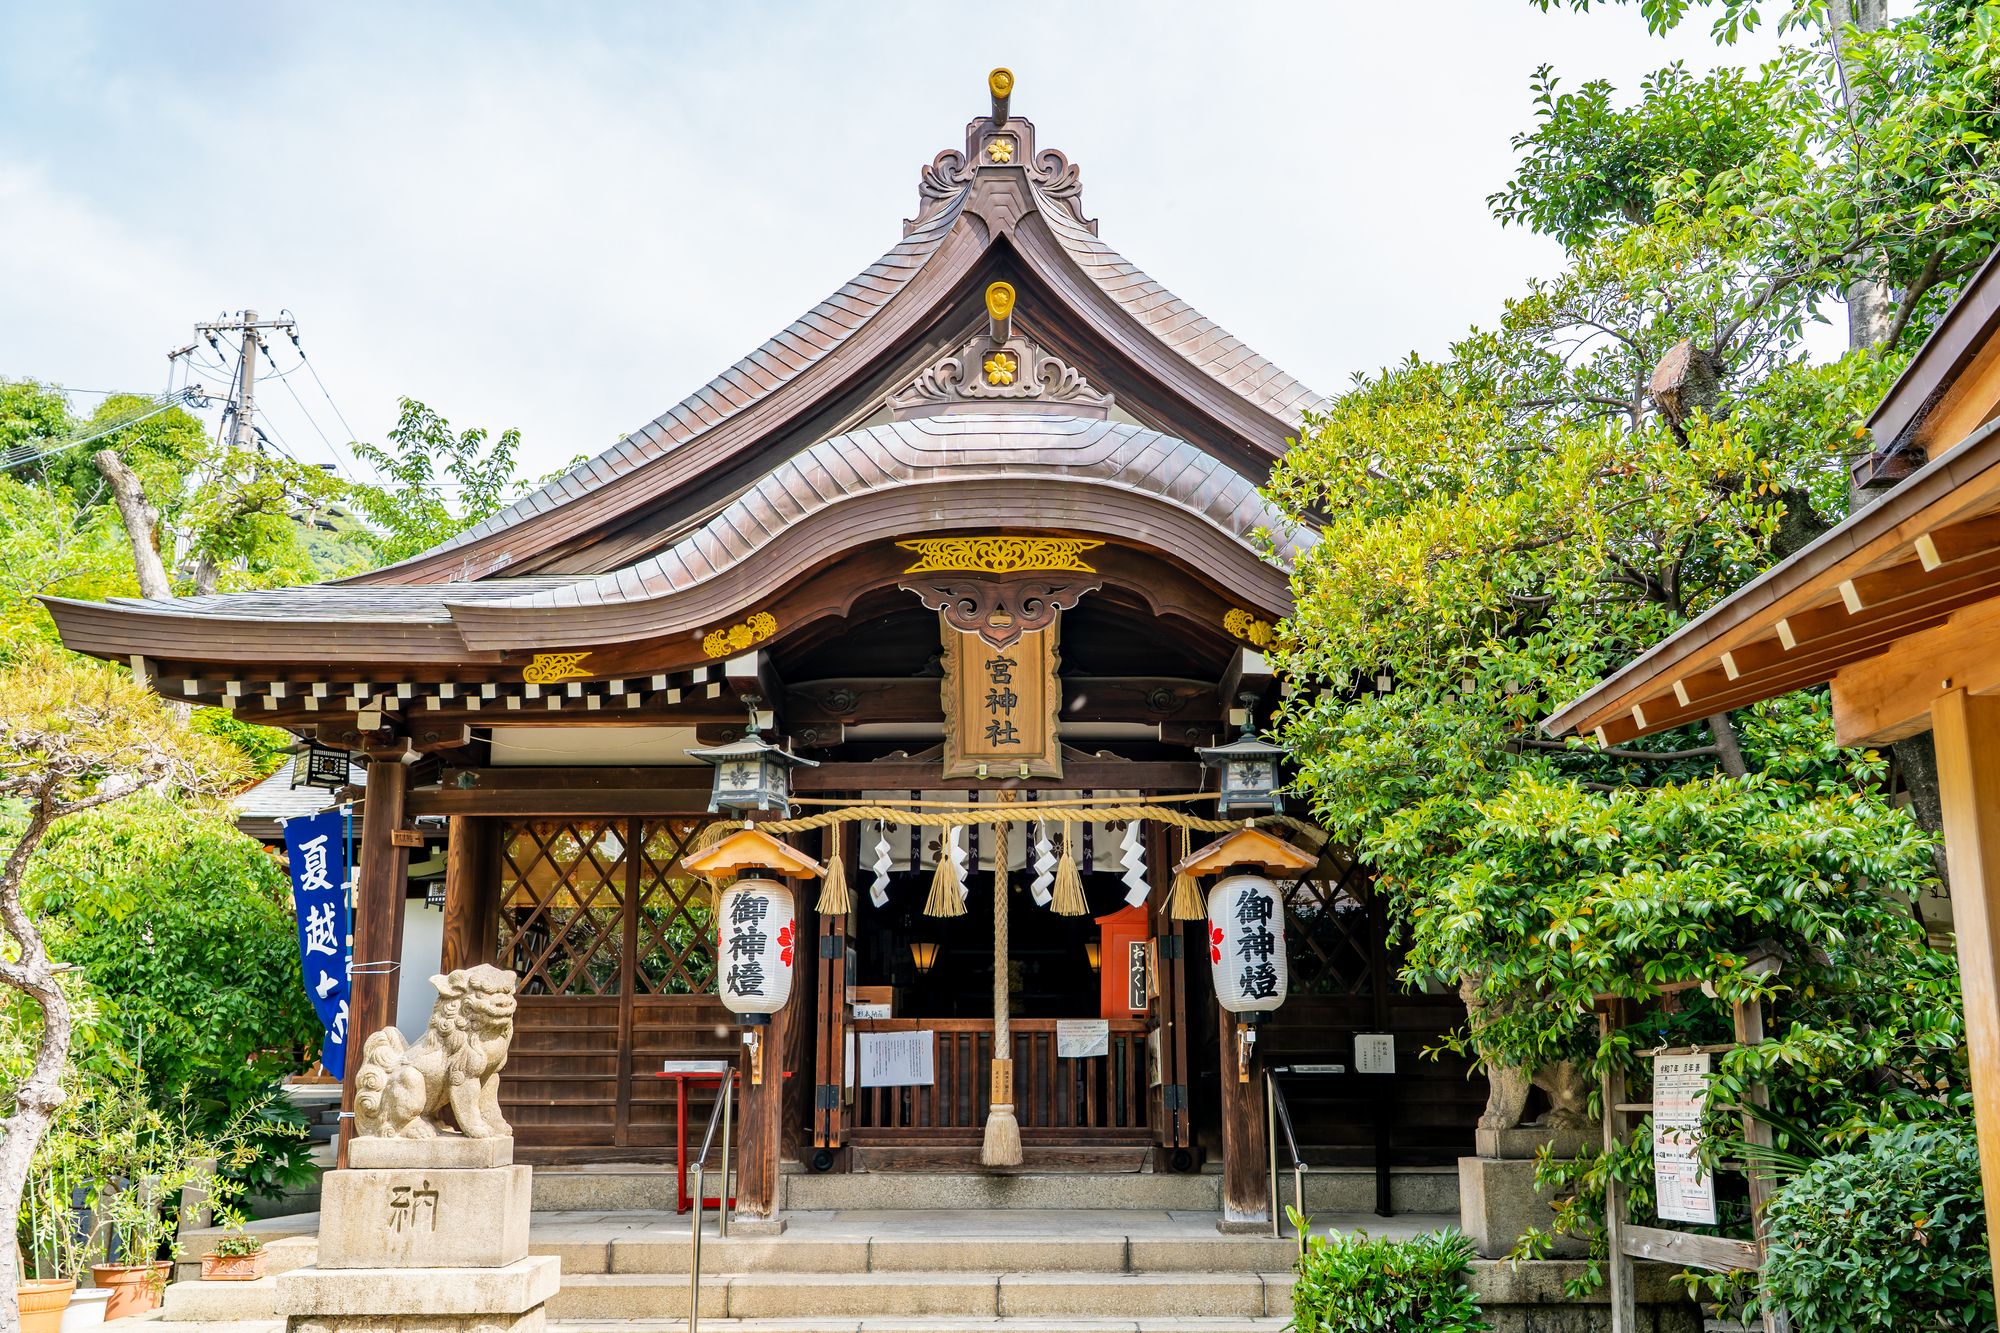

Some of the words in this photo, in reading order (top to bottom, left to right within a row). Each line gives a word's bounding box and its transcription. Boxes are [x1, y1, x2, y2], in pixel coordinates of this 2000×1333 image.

[984, 642, 1020, 748] 宮神社
[726, 890, 770, 997] 御神燈
[1131, 944, 1146, 1007] おみくじ
[1235, 887, 1279, 1001] 御神燈
[389, 1180, 440, 1233] 納
